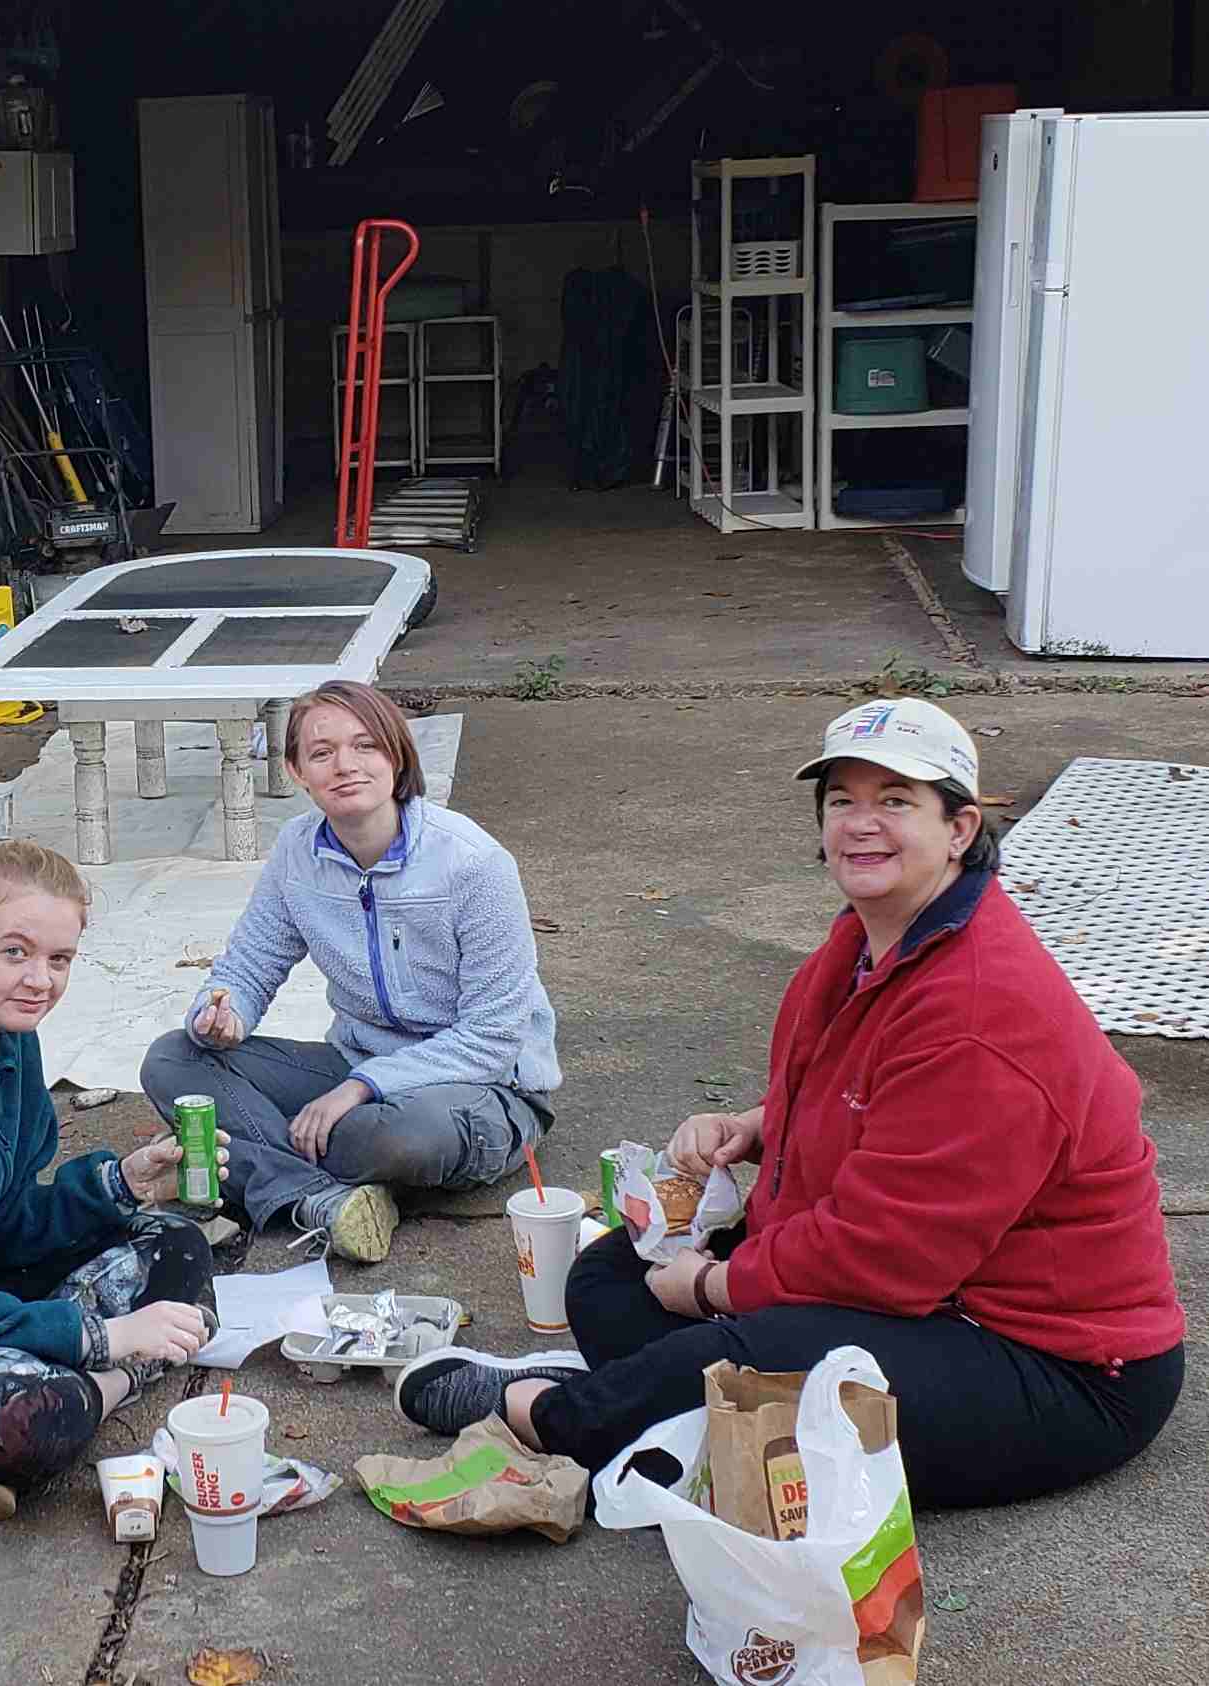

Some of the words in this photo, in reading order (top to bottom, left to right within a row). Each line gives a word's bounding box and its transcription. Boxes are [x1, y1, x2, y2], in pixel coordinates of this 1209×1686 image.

[59, 521, 109, 535] CRAFTSMAN
[191, 1452, 209, 1508] BURGER
[207, 1472, 222, 1509] KING
